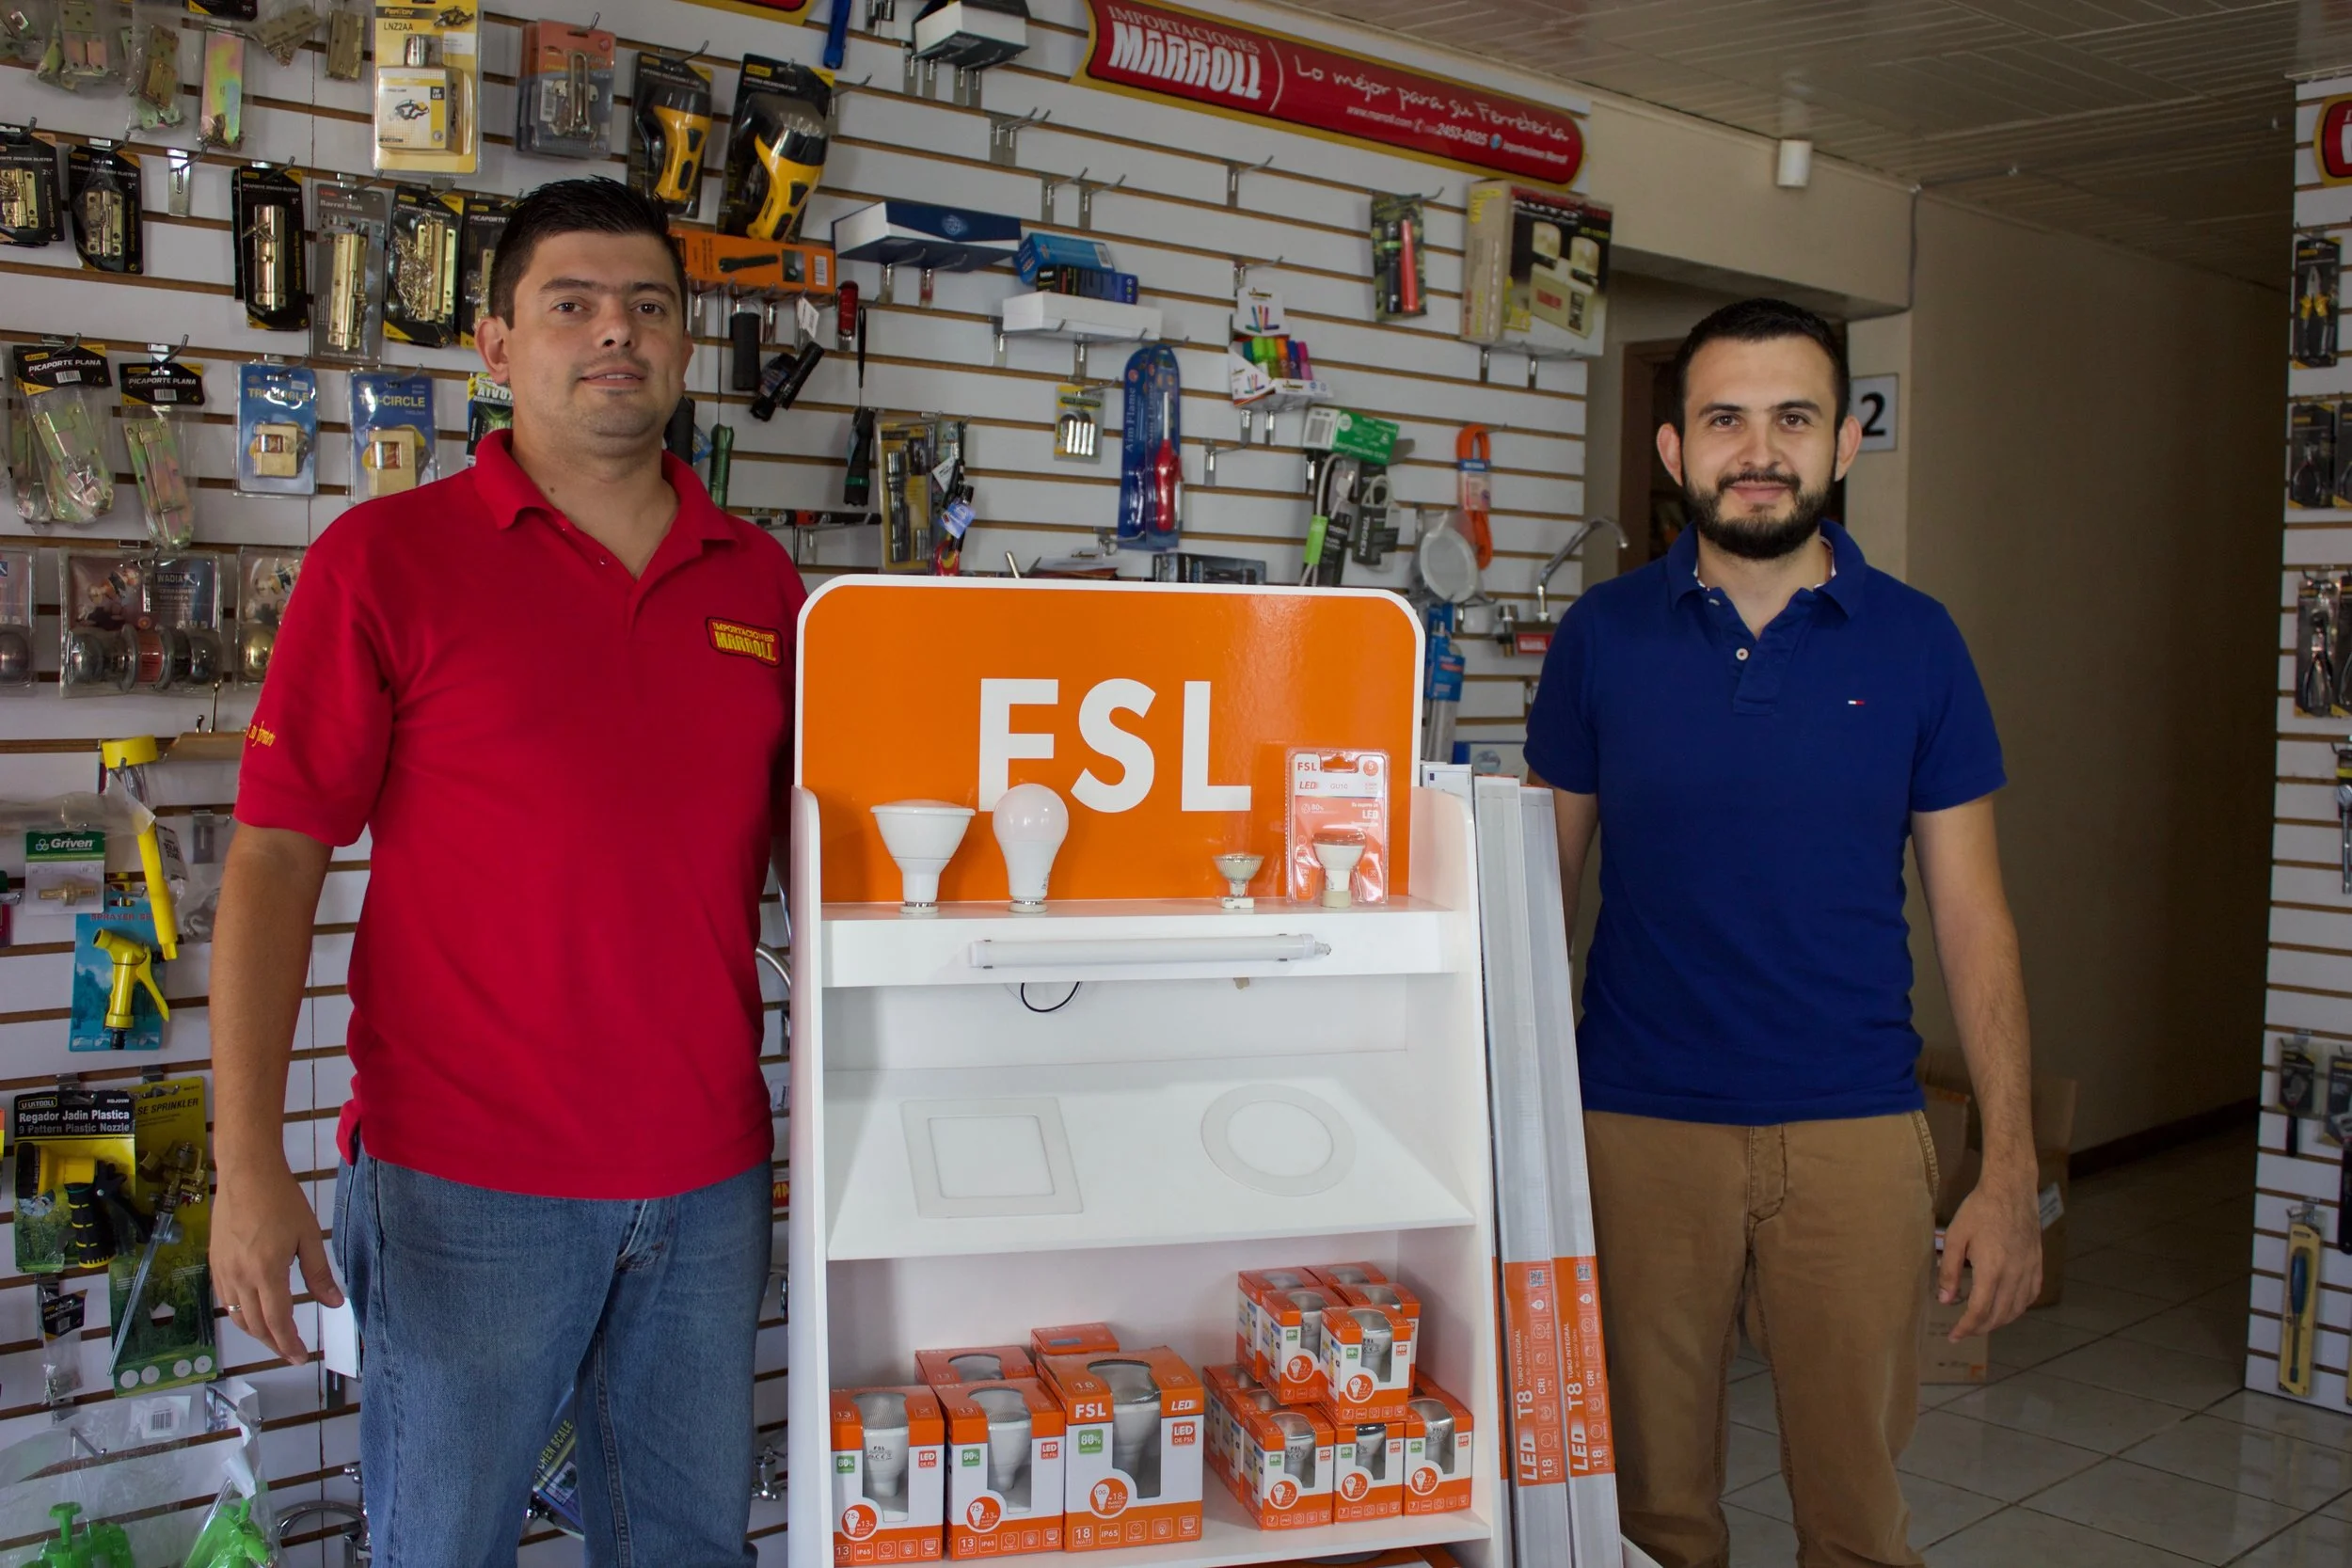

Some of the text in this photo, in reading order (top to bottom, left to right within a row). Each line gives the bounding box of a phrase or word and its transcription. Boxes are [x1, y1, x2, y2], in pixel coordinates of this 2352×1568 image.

[383, 22, 414, 32] LNZ2AA
[1107, 5, 1262, 55] IMPORTACIONES
[1107, 21, 1263, 100] MARROLL
[1294, 54, 1325, 81] Lo
[1396, 87, 1446, 112] para
[28, 358, 102, 372] PICAPORTE PLANA
[128, 376, 197, 386] PICAPORTE PLANA
[1860, 391, 1887, 437] 2
[712, 622, 774, 642] IMPORTACIONES
[715, 631, 776, 661] MARROLL
[978, 678, 1251, 813] FSL
[1297, 762, 1317, 771] FSL
[1299, 781, 1317, 790] LED
[1362, 811, 1378, 819] LED
[51, 838, 93, 848] Griven
[151, 1097, 199, 1114] SPRINKLER
[19, 1111, 60, 1124] Regador
[62, 1110, 88, 1120] Jadin
[91, 1109, 130, 1120] Plastica
[19, 1122, 130, 1134] 9 Pattern Plastic Nozzle
[1564, 1322, 1572, 1357] INTEGRAL
[1586, 1370, 1595, 1386] CRI
[1537, 1377, 1546, 1395] CRI
[1517, 1390, 1534, 1419] T8
[1566, 1383, 1583, 1411] T8
[1075, 1403, 1106, 1418] FSL
[1171, 1400, 1194, 1411] LED
[550, 1418, 574, 1449] SCALE
[1174, 1426, 1194, 1436] LED
[1081, 1433, 1102, 1445] 80%
[1042, 1443, 1057, 1452] LED
[1571, 1428, 1589, 1471] LED
[838, 1459, 854, 1467] 80%
[919, 1452, 936, 1461] LED
[963, 1451, 979, 1461] 80%
[1520, 1433, 1538, 1481] LED
[1592, 1449, 1603, 1467] 18
[1542, 1458, 1553, 1477] 18
[1075, 1528, 1090, 1539] 18
[1101, 1529, 1119, 1538] IP65
[836, 1545, 850, 1556] 13
[961, 1538, 974, 1548] 13
